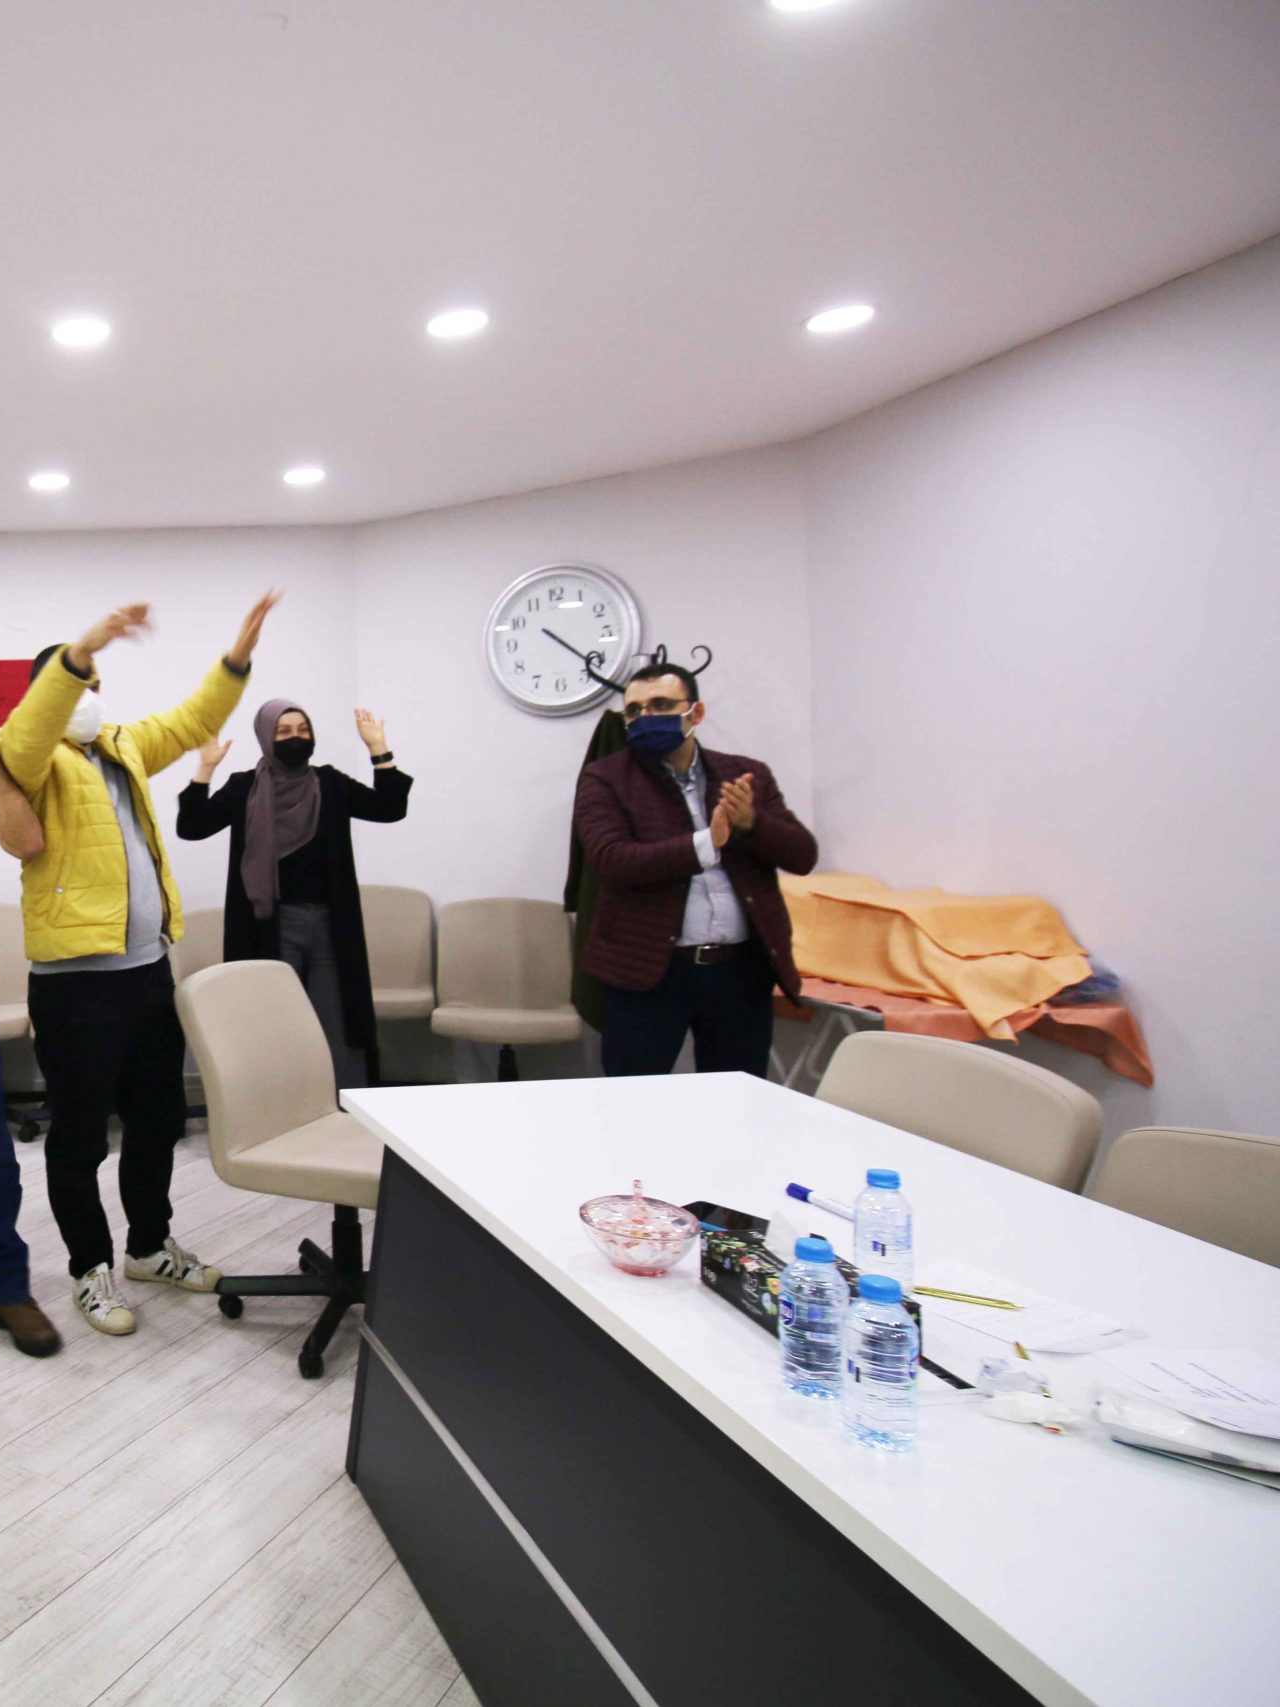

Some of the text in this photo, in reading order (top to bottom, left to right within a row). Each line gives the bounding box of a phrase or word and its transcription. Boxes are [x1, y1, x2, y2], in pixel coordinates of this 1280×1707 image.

[549, 586, 564, 602] 12
[528, 597, 540, 612] 11
[593, 603, 604, 618] 2
[512, 616, 526, 631] 10
[506, 639, 518, 653] 9
[514, 660, 526, 675] 8
[532, 675, 541, 688] 7
[555, 677, 567, 692] 6
